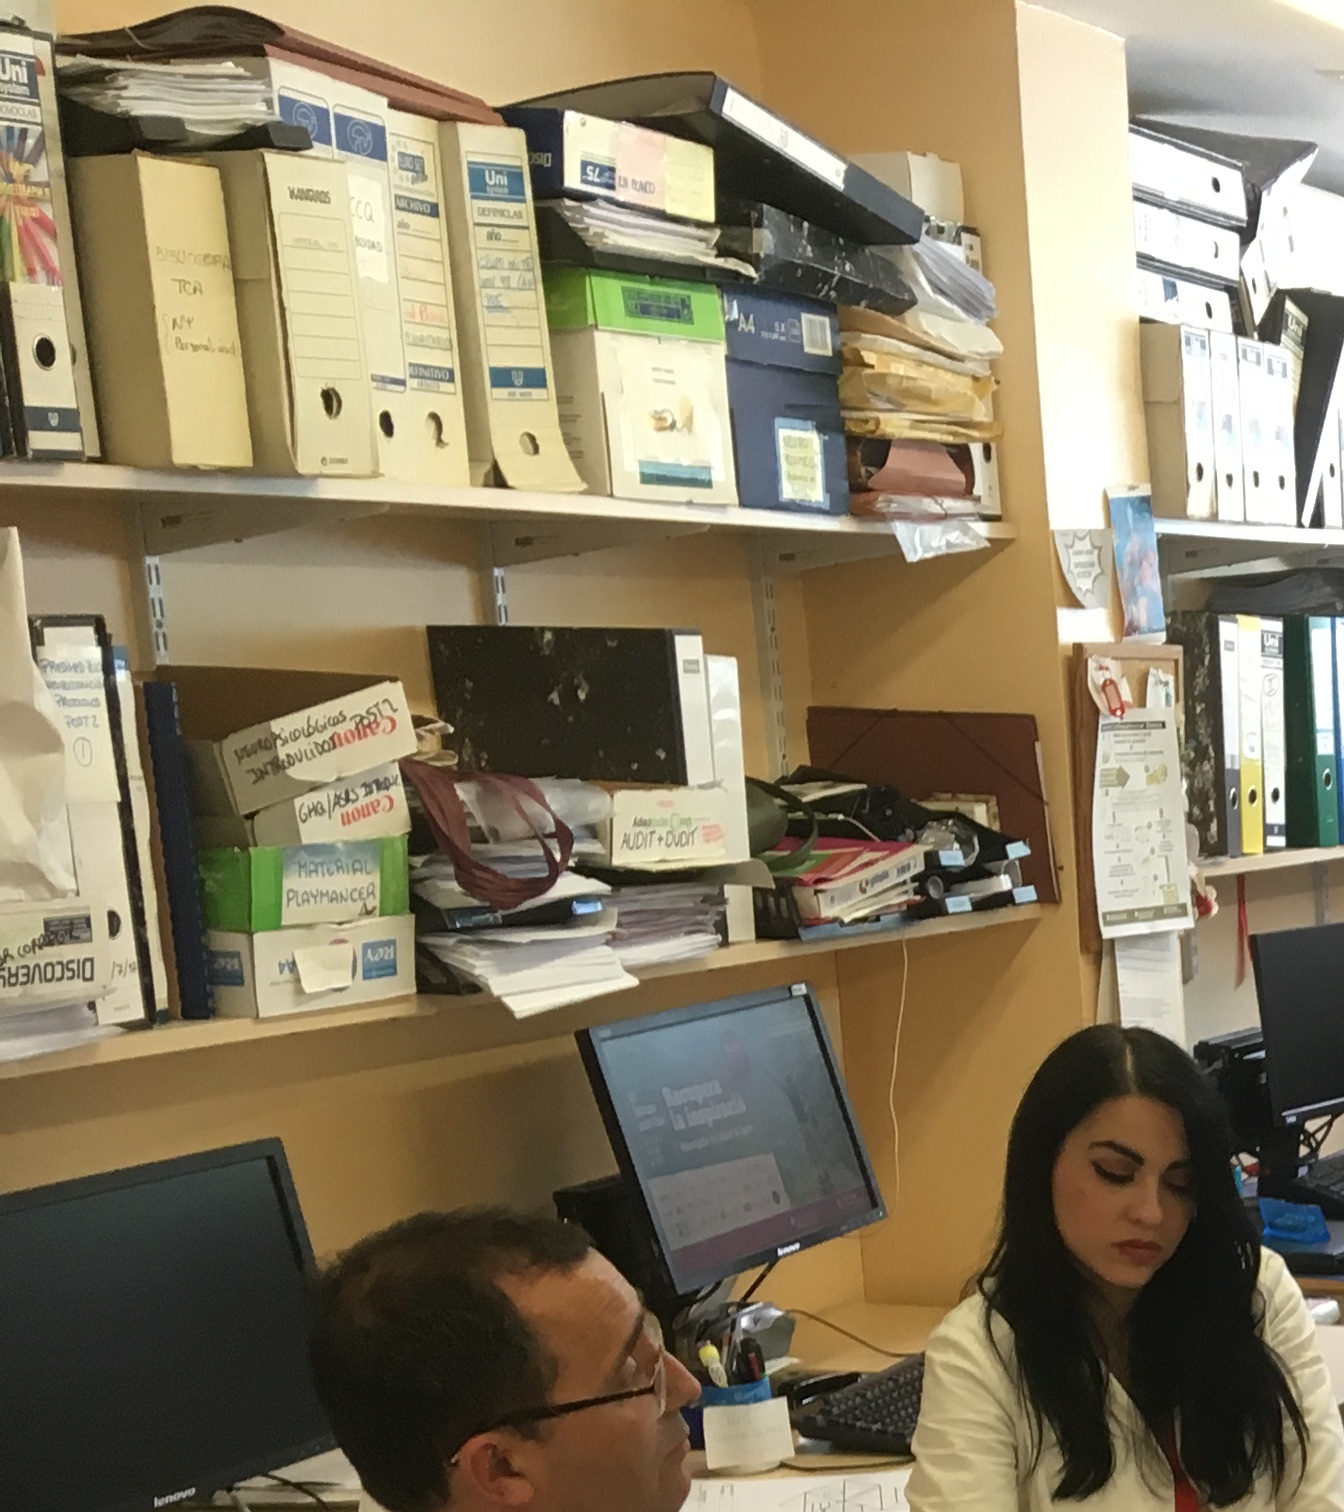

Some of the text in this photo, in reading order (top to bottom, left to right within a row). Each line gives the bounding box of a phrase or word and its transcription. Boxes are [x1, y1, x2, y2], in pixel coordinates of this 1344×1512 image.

[485, 170, 508, 186] Uni
[486, 229, 502, 242] año
[171, 278, 204, 296] TCA
[738, 312, 756, 334] A4
[331, 715, 397, 750] Canon
[340, 794, 395, 827] Canon
[620, 830, 657, 851] AUDIT
[665, 826, 699, 849] DUDIT
[297, 858, 372, 879] MATERIAL
[286, 882, 376, 908] PLAYMANCER
[0, 956, 94, 988] DISCOVERY
[153, 1486, 196, 1508] lenovo
